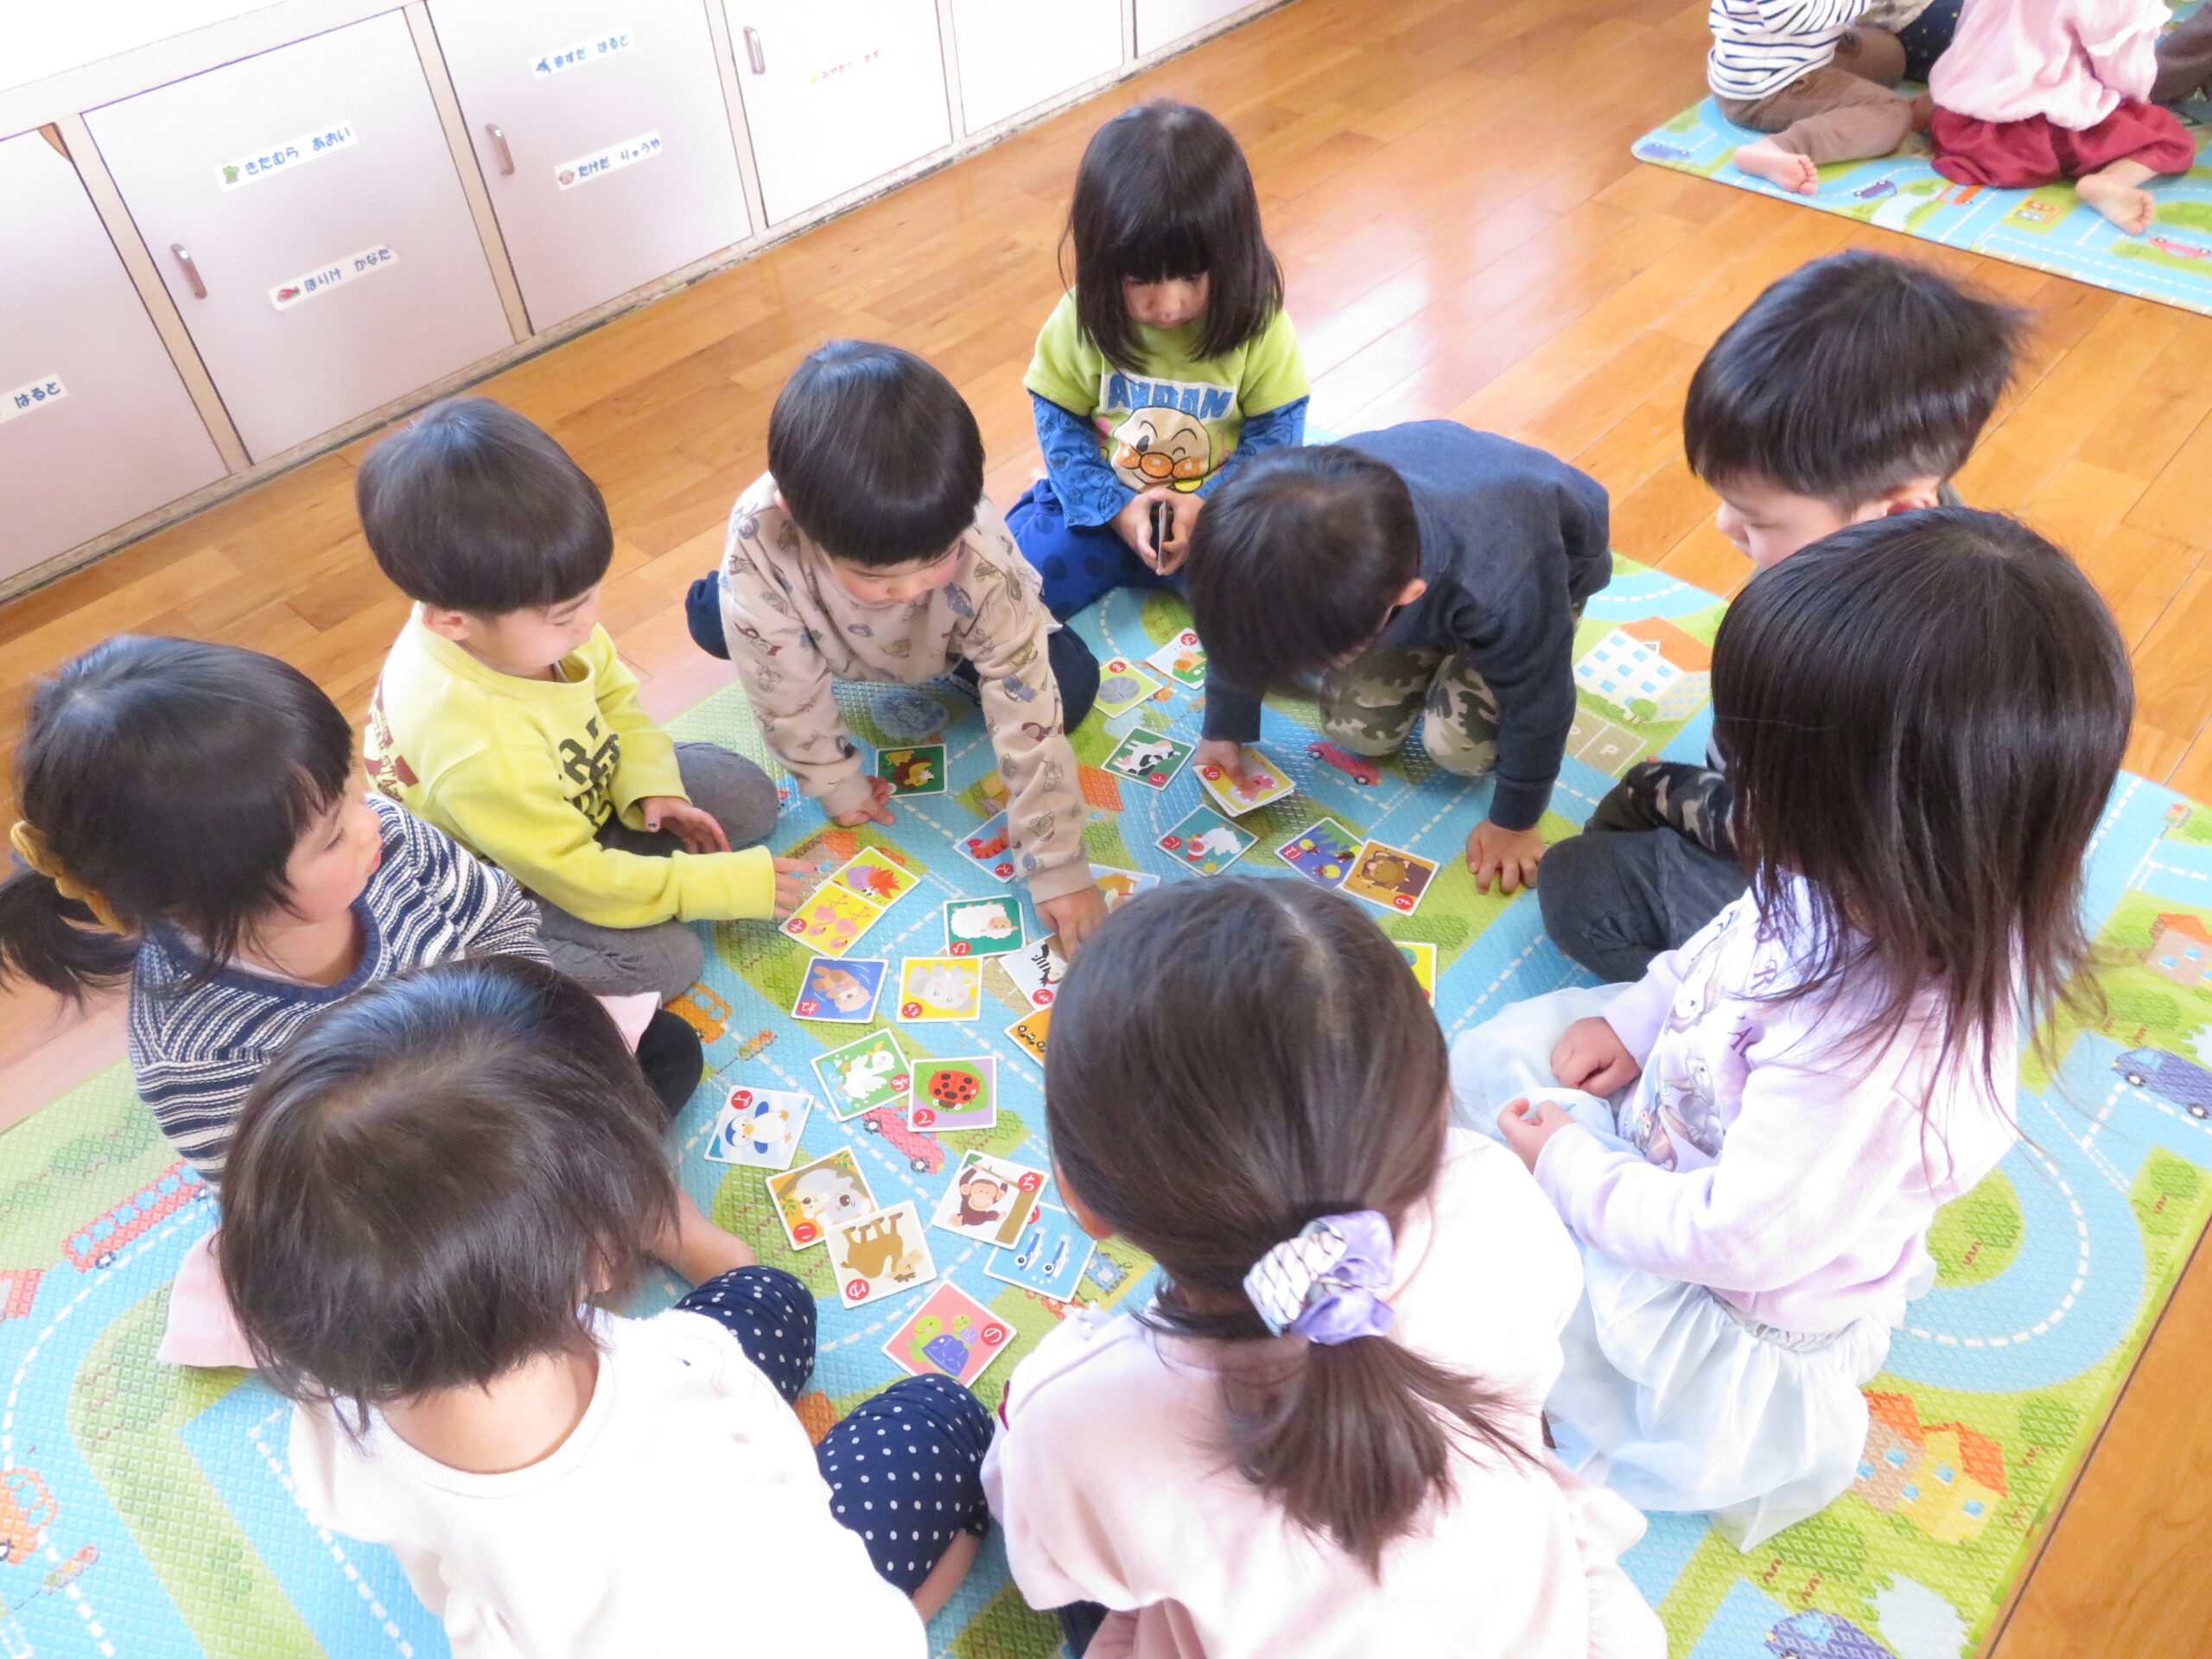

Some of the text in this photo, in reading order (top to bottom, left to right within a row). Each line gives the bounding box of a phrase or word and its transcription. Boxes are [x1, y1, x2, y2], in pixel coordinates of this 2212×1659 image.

[554, 35, 629, 68] ますだ はると
[245, 127, 351, 175] きたむら あおい
[578, 138, 660, 177] たけだ りゅうや
[304, 249, 391, 292] ほりけ かなた
[14, 382, 61, 409] はると
[904, 1004, 919, 1016] な
[892, 1077, 909, 1090] あ
[733, 1094, 751, 1106] よ
[918, 1111, 932, 1124] て
[1023, 1174, 1035, 1191] ち
[798, 1225, 812, 1239] こ
[849, 1282, 867, 1298] ゆ
[983, 1327, 1002, 1343] の
